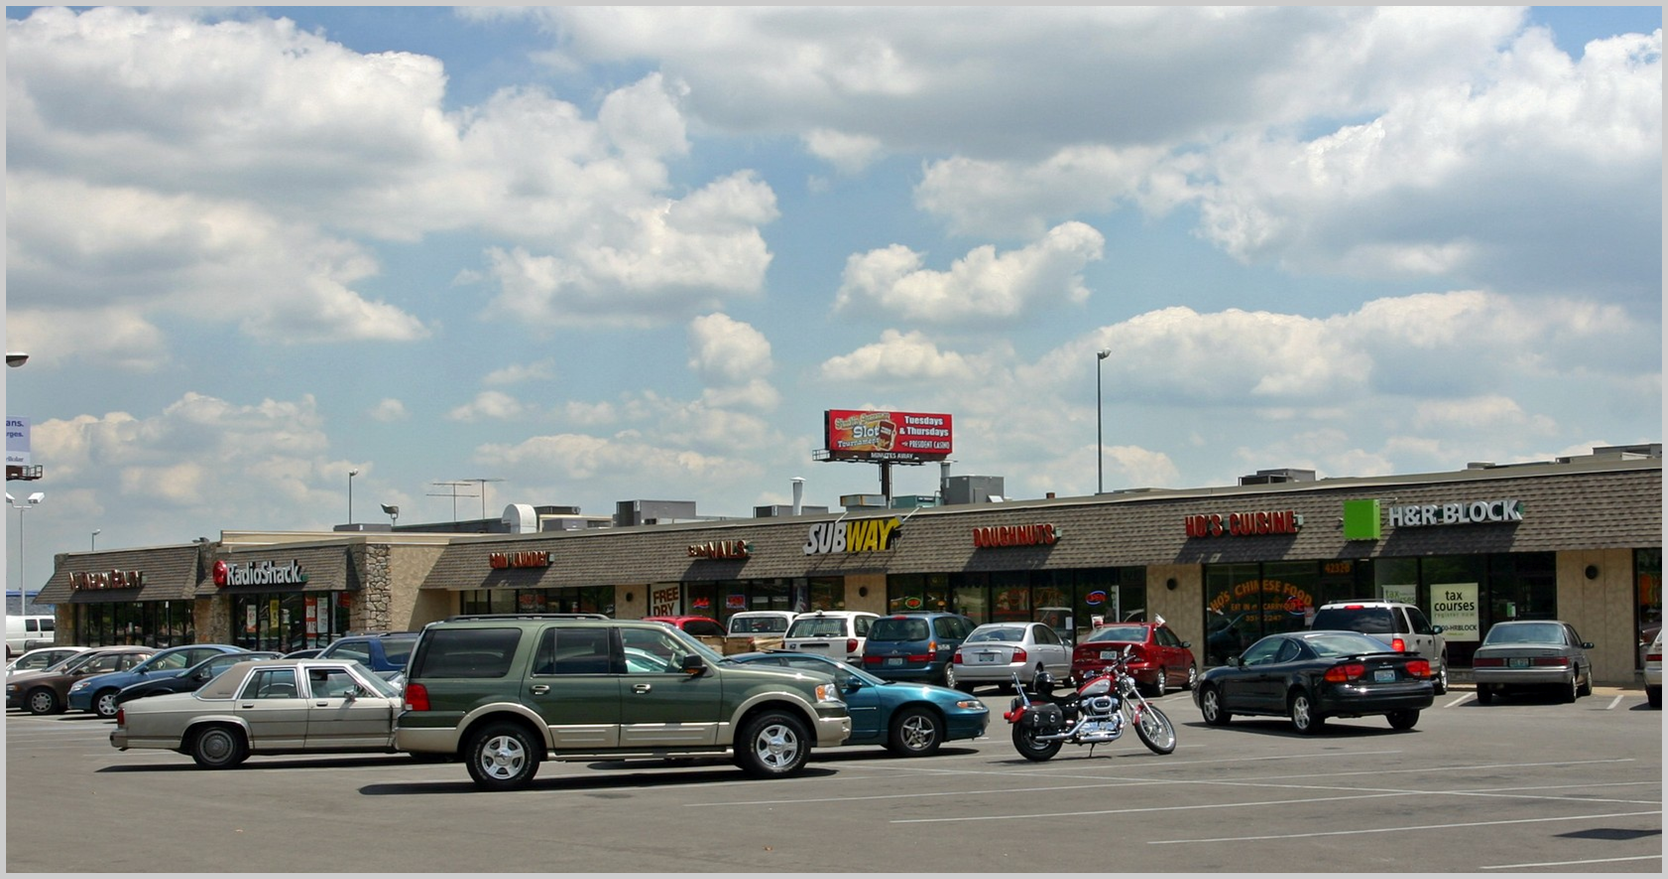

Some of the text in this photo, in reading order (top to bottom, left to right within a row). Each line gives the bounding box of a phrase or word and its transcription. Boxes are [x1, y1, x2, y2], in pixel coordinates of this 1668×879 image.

[904, 415, 943, 425] Tuesdays
[853, 425, 880, 438] Slot
[899, 427, 949, 437] & Thursdays
[1389, 499, 1523, 527] H&R BLOCK
[1185, 509, 1298, 537] HO'S CUISINE
[802, 515, 902, 555] SUBWAY
[973, 522, 1055, 548] DOUGHNUTS
[708, 540, 747, 558] NAILS
[227, 559, 302, 586] RadioShack
[653, 586, 679, 605] FREE
[1283, 582, 1313, 606] FOOD
[1445, 591, 1463, 601] tax
[653, 602, 674, 616] DRY
[1434, 601, 1475, 611] courses
